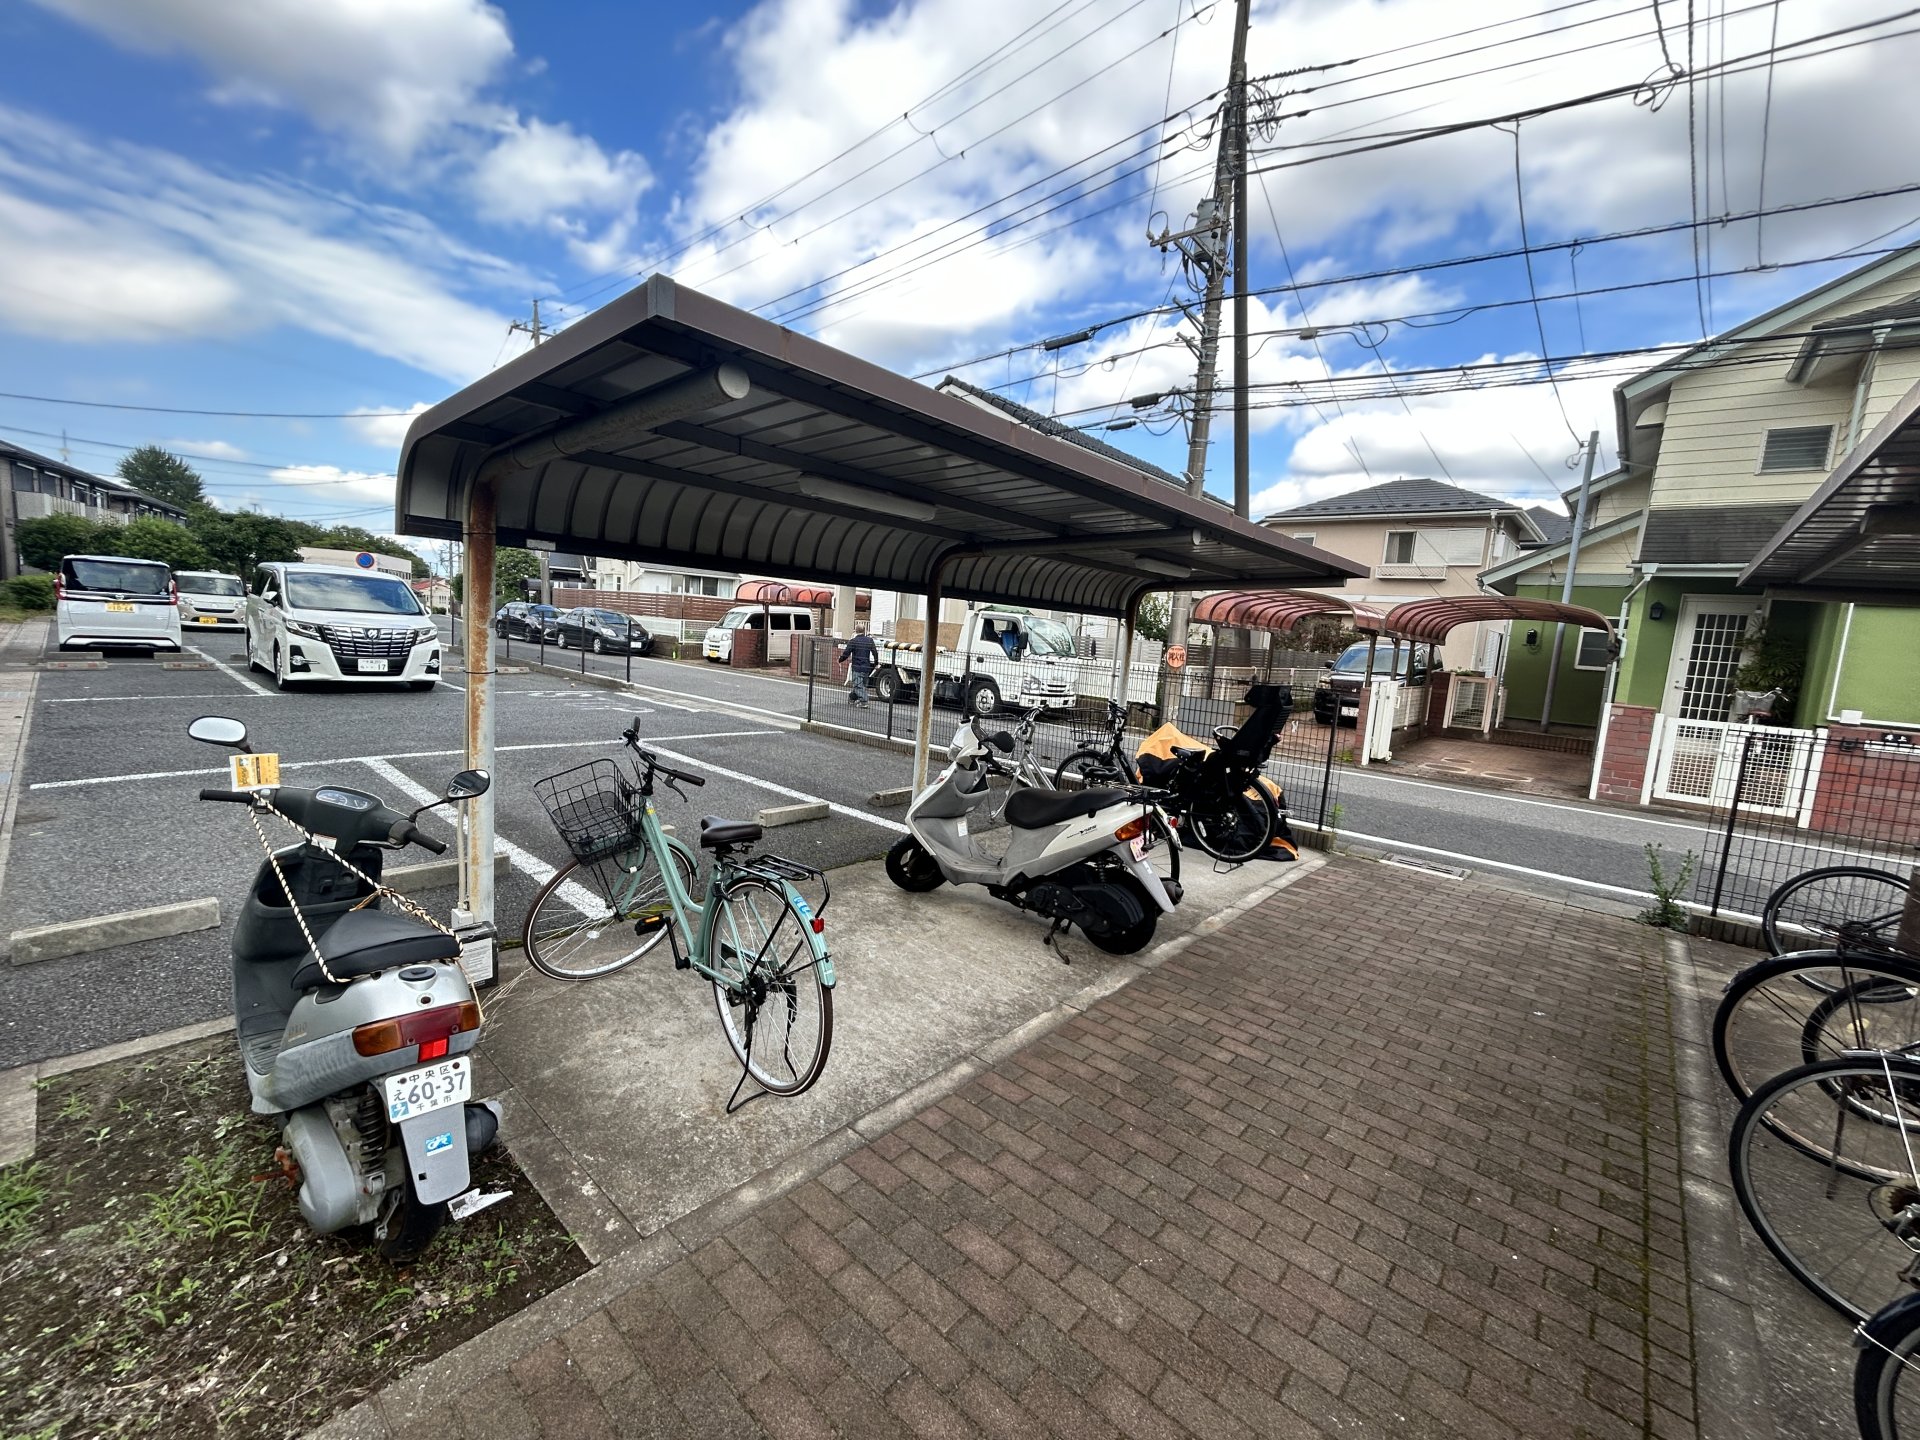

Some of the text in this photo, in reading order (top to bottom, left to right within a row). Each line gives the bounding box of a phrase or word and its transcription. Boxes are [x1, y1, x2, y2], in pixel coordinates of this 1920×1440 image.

[408, 1064, 450, 1083] 中央区
[393, 1071, 466, 1104] え 60-37
[416, 1095, 452, 1111] 千葉市
